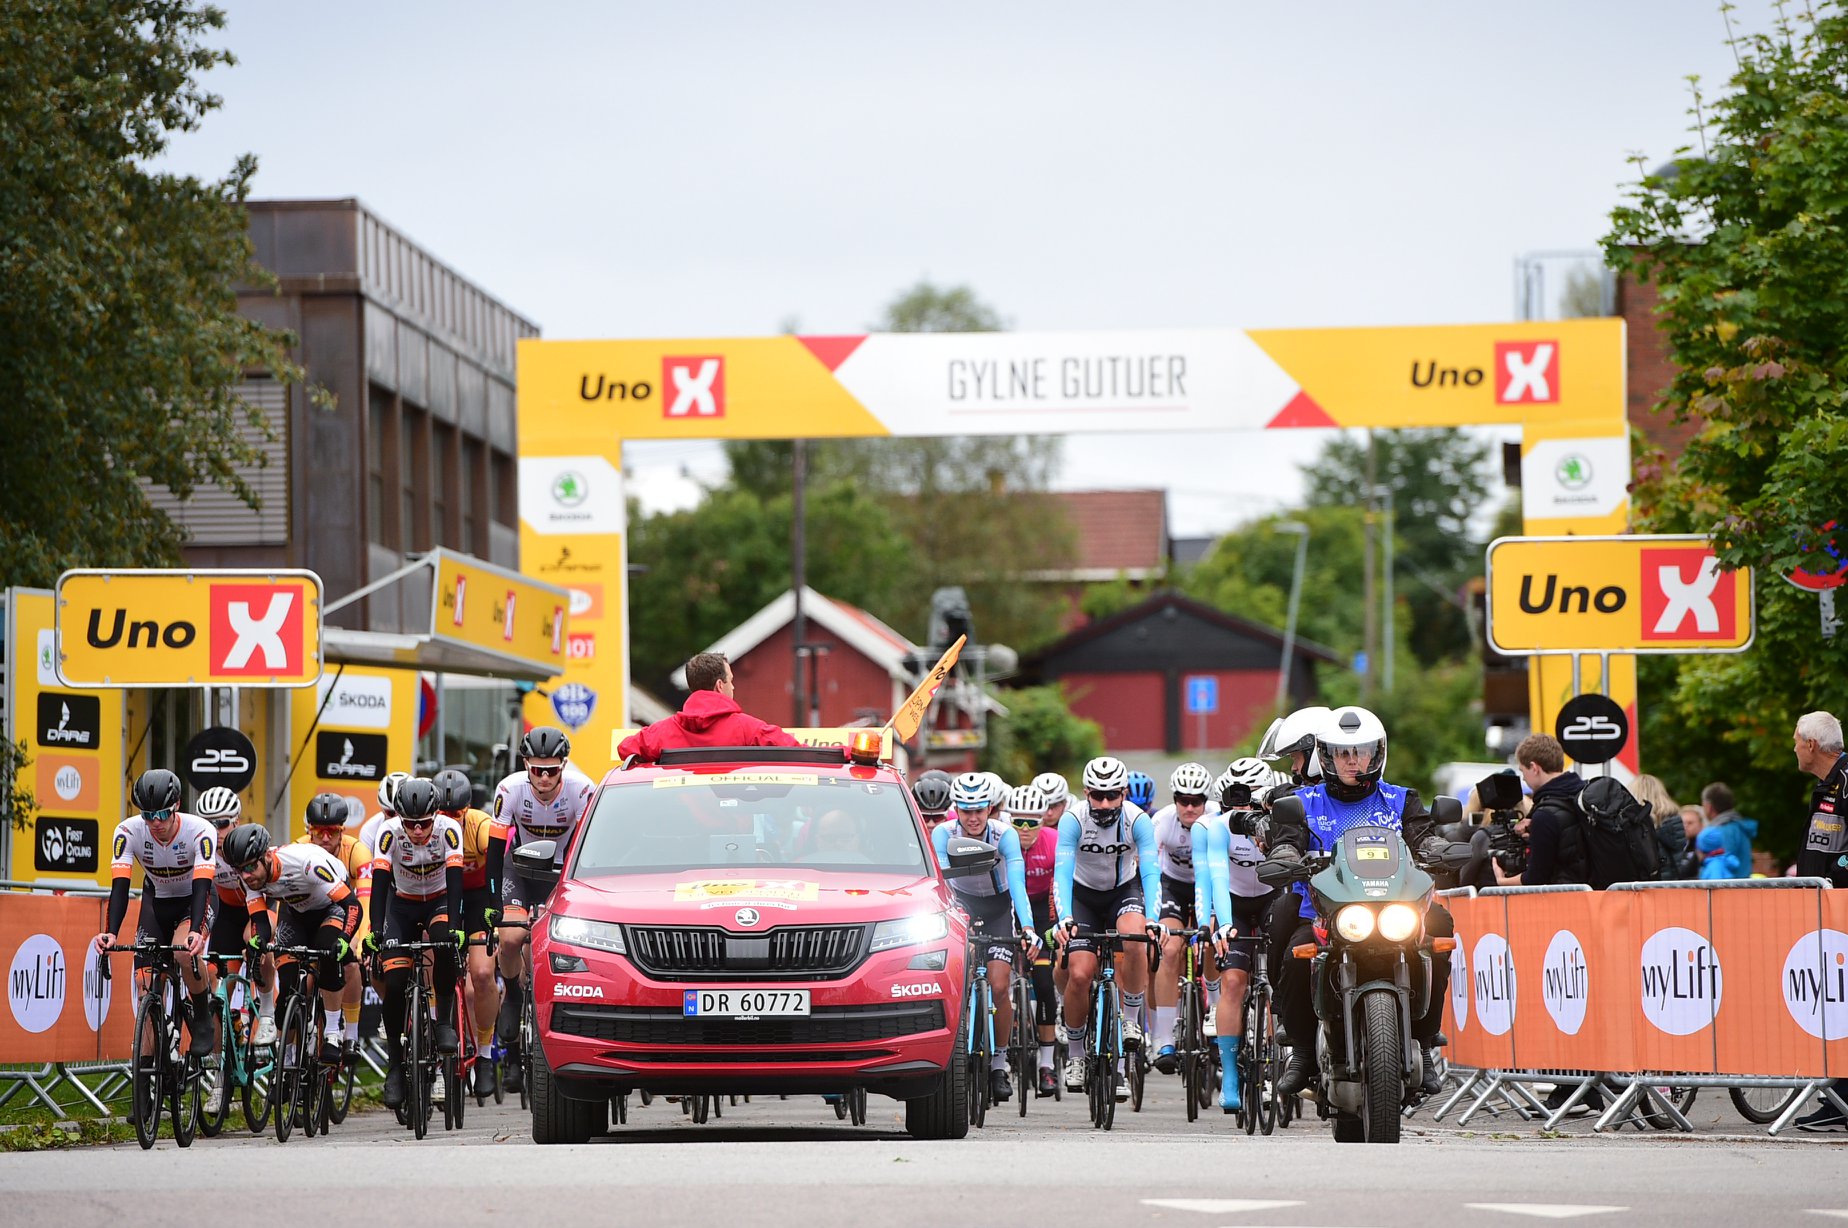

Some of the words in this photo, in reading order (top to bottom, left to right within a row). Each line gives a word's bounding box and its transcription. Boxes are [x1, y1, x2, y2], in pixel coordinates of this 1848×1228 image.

[948, 358, 1048, 400] GYLNE
[1062, 355, 1187, 399] GUTUER
[1411, 361, 1485, 388] Uno
[1502, 343, 1554, 401] X
[580, 374, 652, 401] Uno
[669, 358, 720, 415] X
[1518, 574, 1627, 614] Uno
[1652, 555, 1721, 633] X
[87, 608, 196, 649] Uno
[222, 592, 294, 668] X
[339, 693, 386, 708] ŠKODA
[47, 728, 90, 743] DARE
[1562, 716, 1621, 741] 25
[192, 749, 249, 773] 25
[327, 763, 377, 776] DARE
[710, 775, 784, 783] OFFICIAL
[866, 784, 878, 794] F
[1361, 880, 1389, 888] YAMAHA
[12, 950, 64, 1012] myLift
[553, 982, 604, 998] ŠKODA
[891, 982, 943, 998] ŠKODA
[1546, 947, 1585, 1012] myLift
[1642, 945, 1718, 1011] myLift
[702, 993, 730, 1012] DR
[740, 993, 804, 1012] 60772
